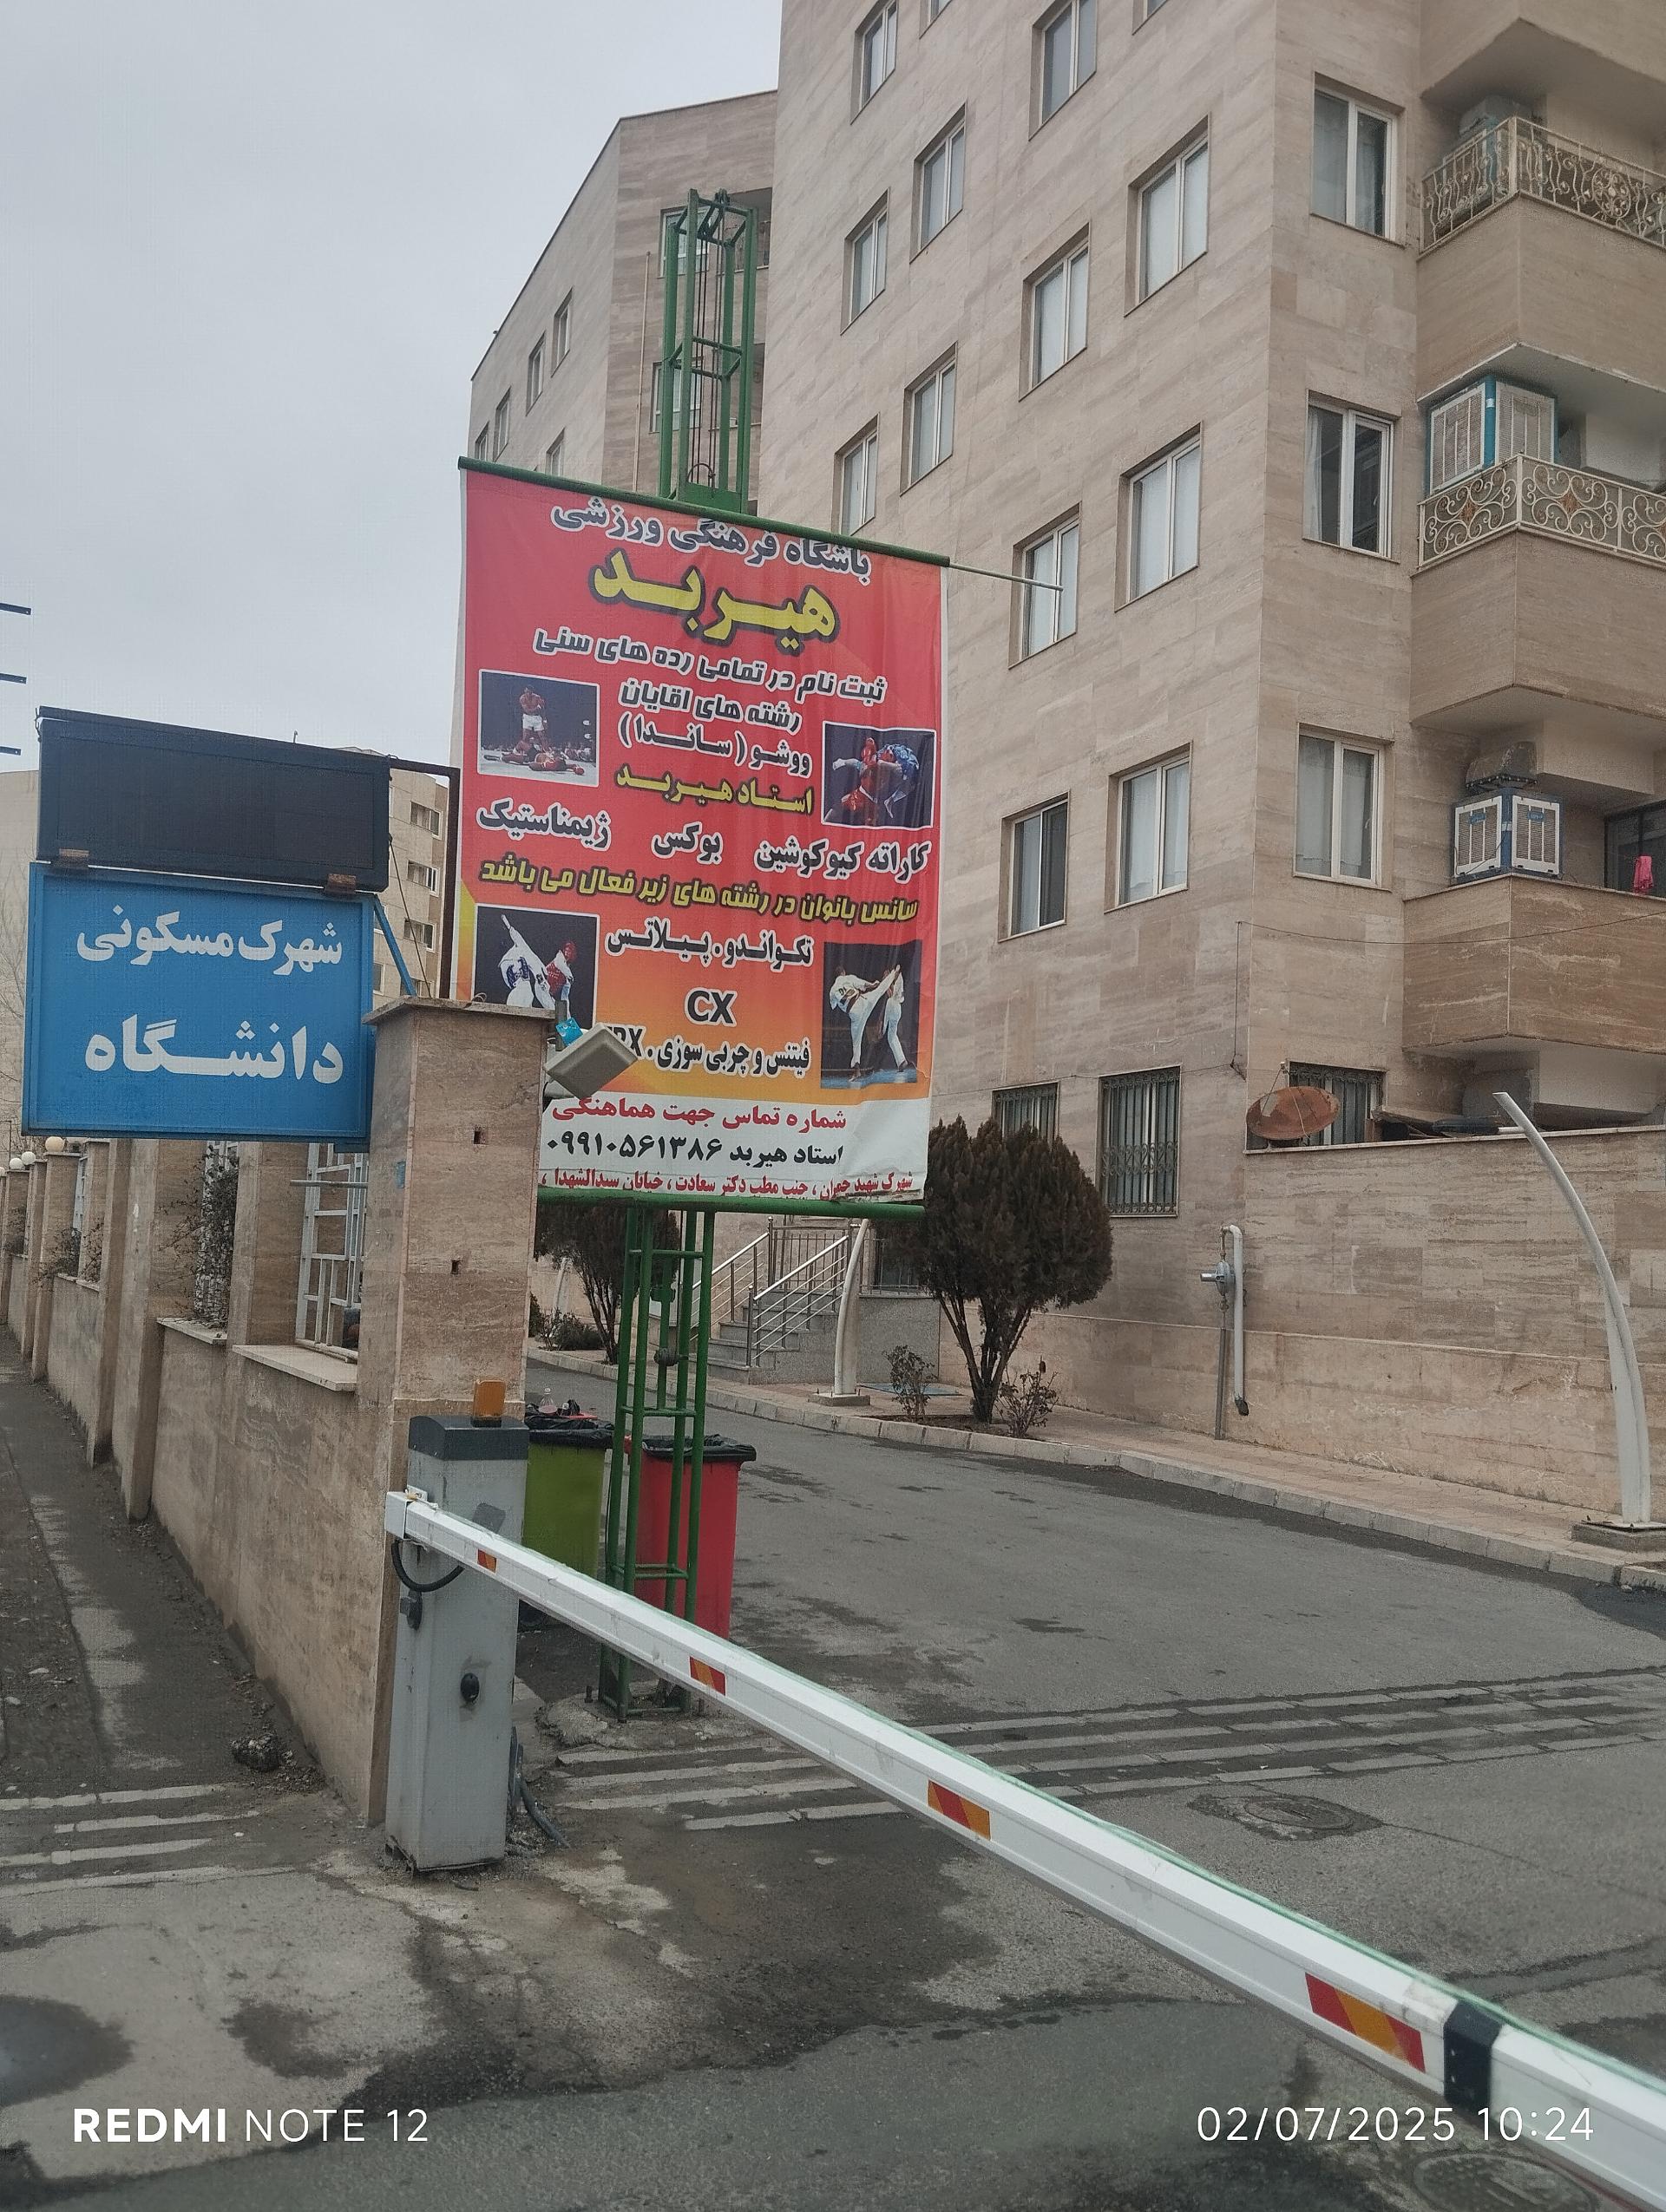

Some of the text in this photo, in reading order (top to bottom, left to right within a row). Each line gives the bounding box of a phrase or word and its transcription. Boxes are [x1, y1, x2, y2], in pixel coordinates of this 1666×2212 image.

[553, 498, 870, 585] باشگاه فرهنگی ورزشی
[591, 549, 839, 651] هیربد
[535, 629, 887, 704] ثبت نام در تمامی رده های سنی
[619, 678, 802, 733] رشته های اقایان
[750, 741, 811, 776] ووشو
[615, 765, 814, 814] استاد هیربد
[477, 800, 610, 848] ژیمناستیک
[653, 822, 722, 863] بوکس
[867, 841, 930, 882] کاراته
[481, 853, 920, 925] سانس بانوان در رشته های زیر فعال می باشد
[75, 904, 343, 977] شهرک مسکونی
[607, 918, 710, 965] پیلاتس
[686, 989, 736, 1024] CX
[83, 1012, 344, 1085] دانشگاه
[705, 1042, 751, 1074] چربی
[752, 1049, 763, 1074] و
[766, 1038, 811, 1077] فیتنس
[551, 1096, 848, 1134] شماره تماس جهت هماهنگی
[547, 1129, 844, 1168] استاد هیربد ۰۹۹۱۰۵۶۱۳۸۶
